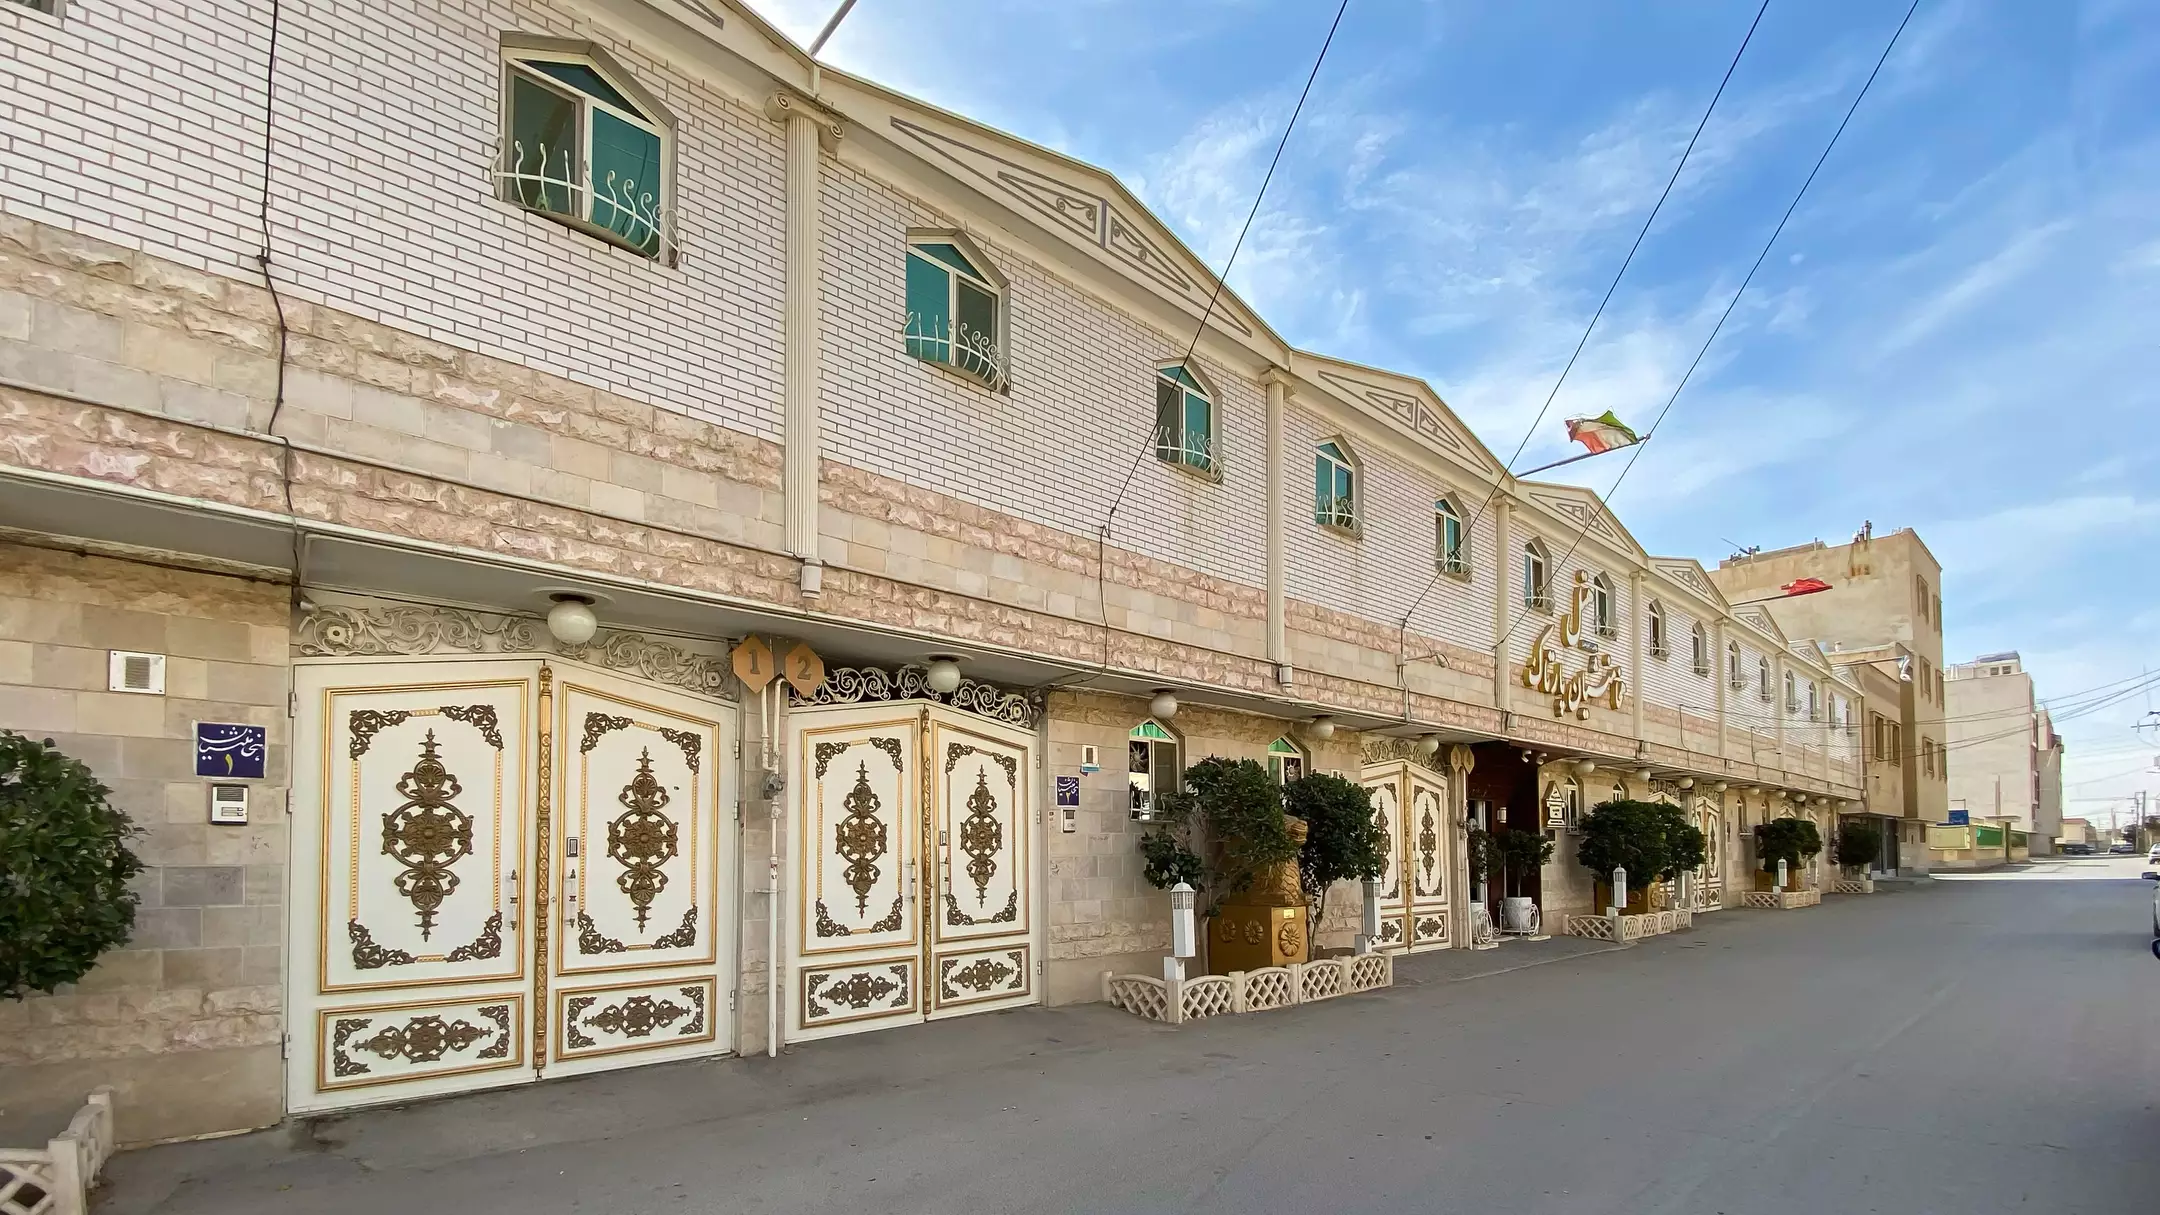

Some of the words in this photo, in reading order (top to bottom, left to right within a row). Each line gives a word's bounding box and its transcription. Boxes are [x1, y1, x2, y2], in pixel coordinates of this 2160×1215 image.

[1561, 569, 1595, 648] هتل
[748, 649, 760, 675] 1
[797, 656, 811, 680] 2
